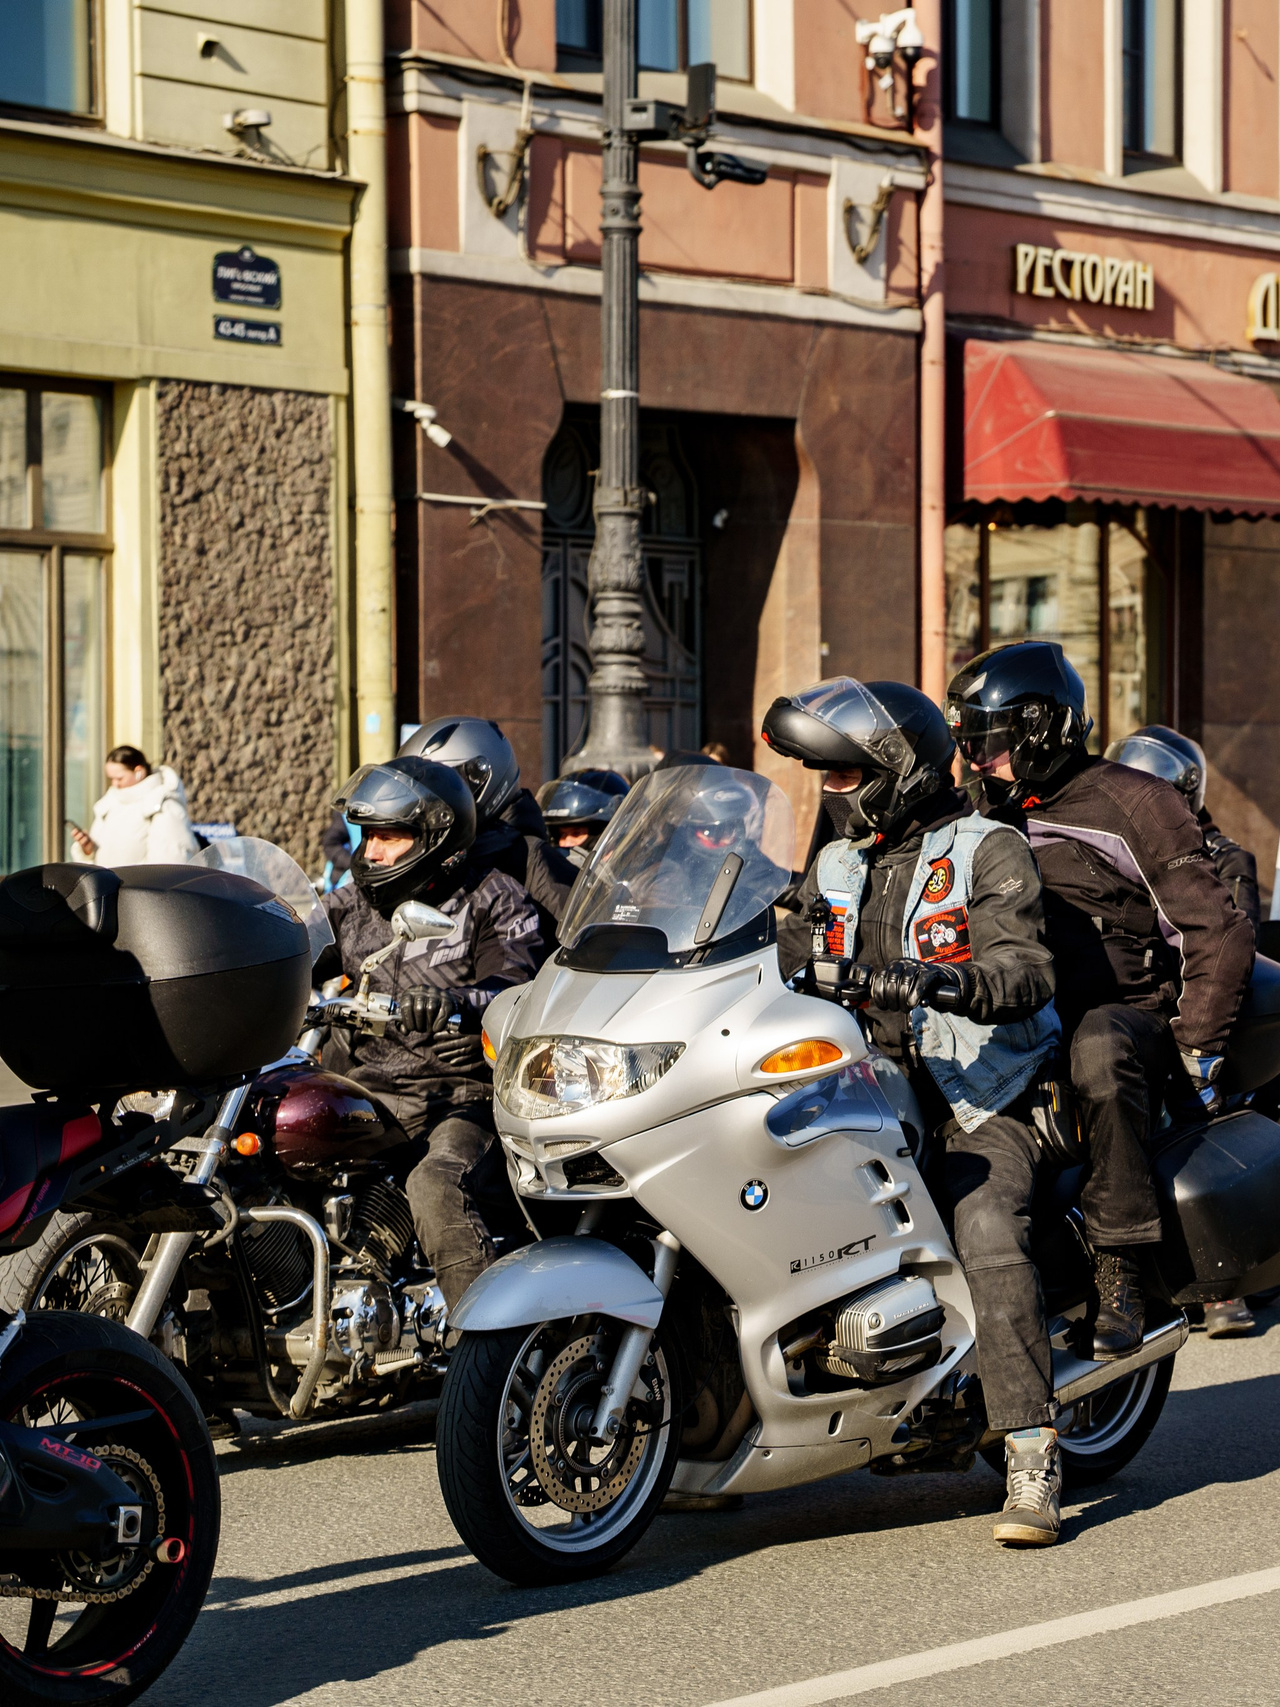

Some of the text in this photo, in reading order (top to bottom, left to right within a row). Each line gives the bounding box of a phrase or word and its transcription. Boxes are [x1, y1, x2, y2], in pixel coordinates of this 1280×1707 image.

[1016, 243, 1155, 311] РЕСТОРАН
[651, 1378, 662, 1401] BMW
[40, 1437, 102, 1470] MT-10
